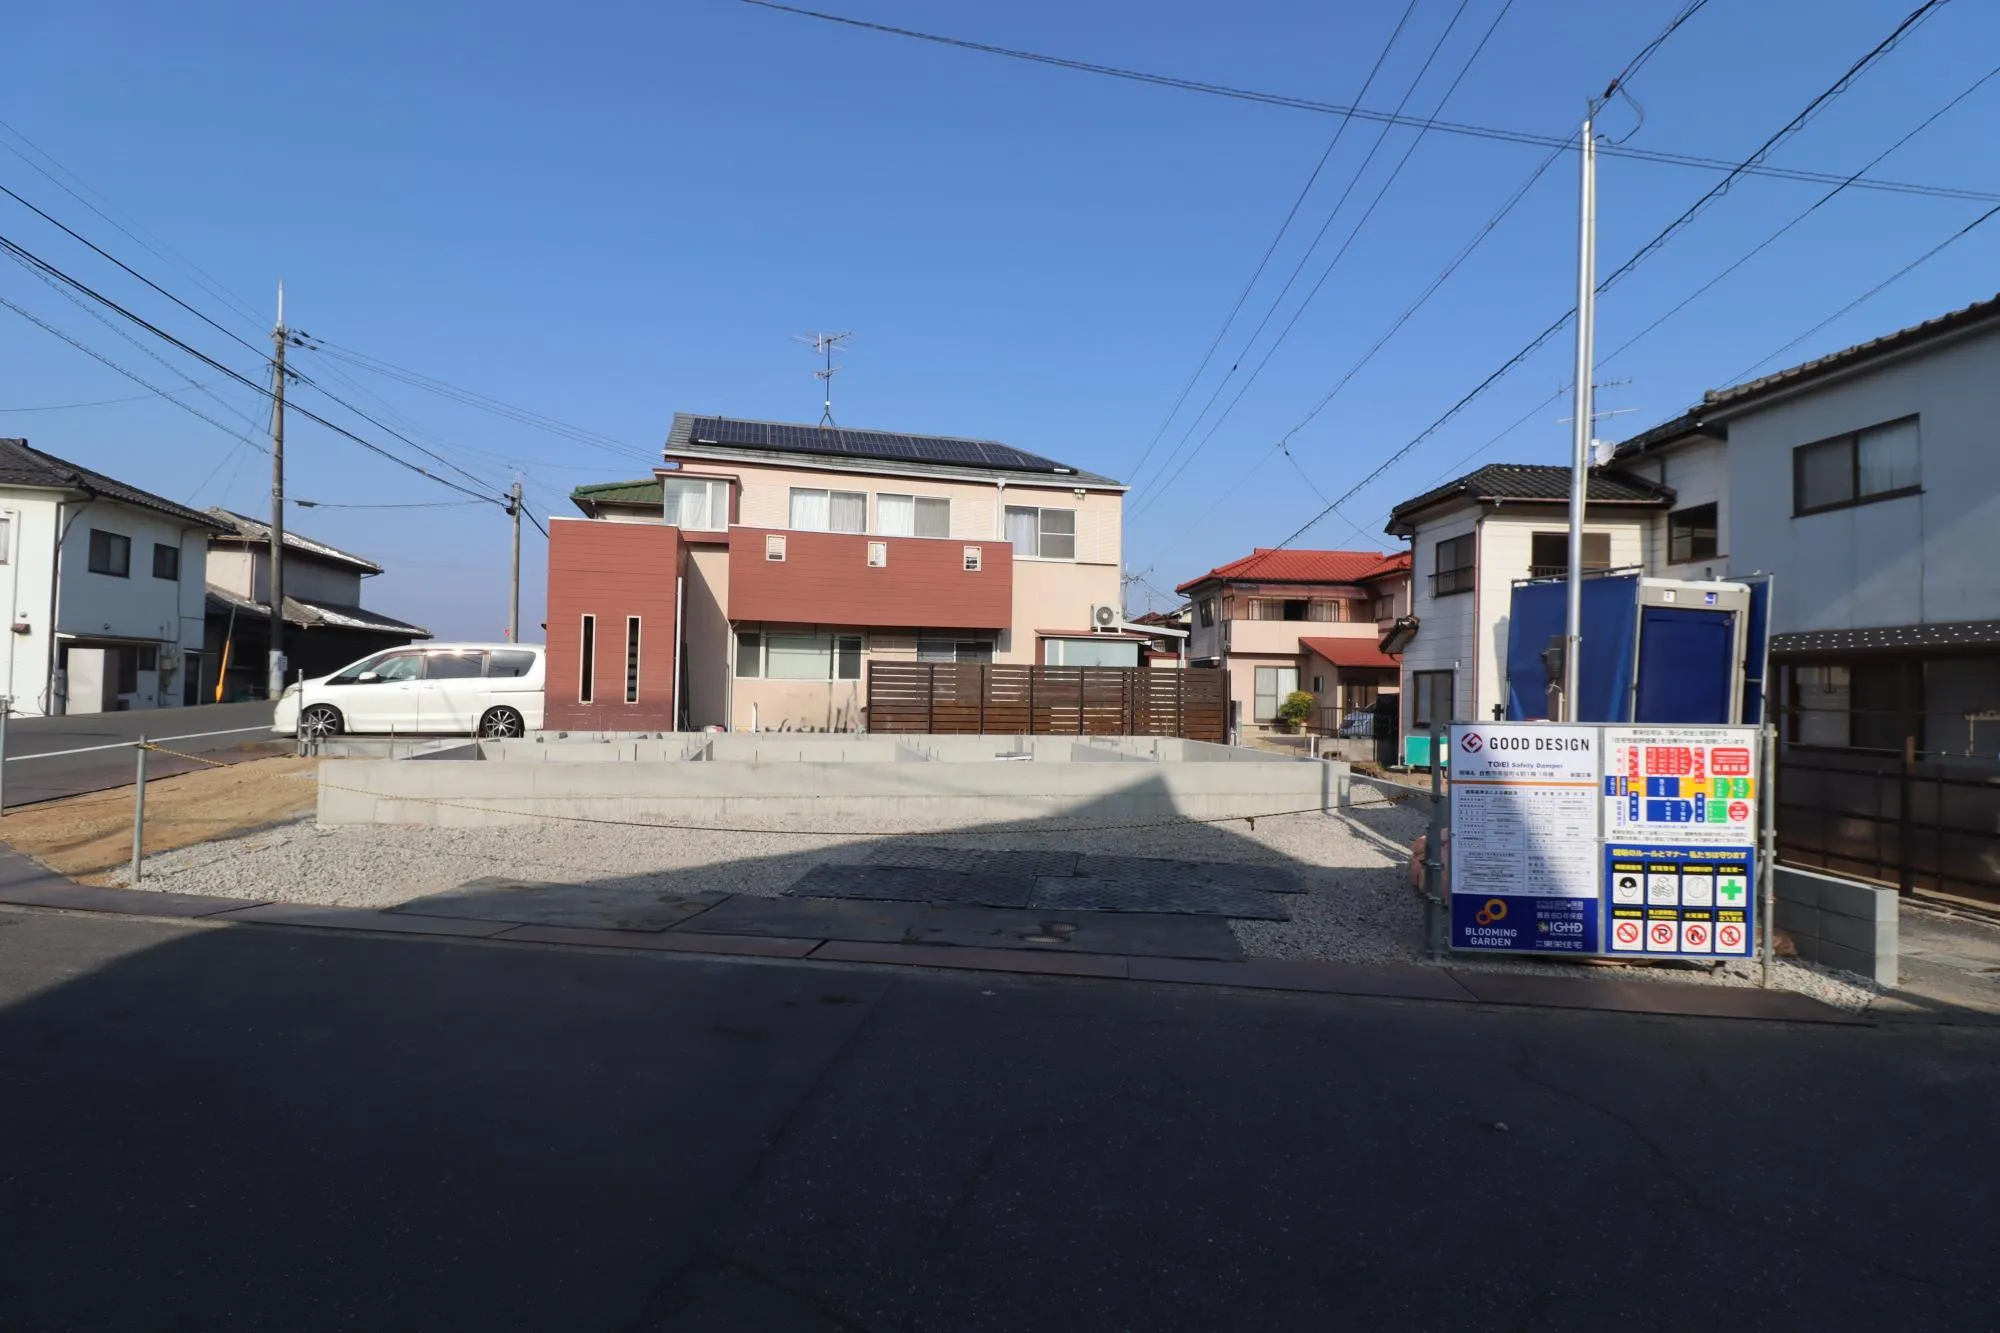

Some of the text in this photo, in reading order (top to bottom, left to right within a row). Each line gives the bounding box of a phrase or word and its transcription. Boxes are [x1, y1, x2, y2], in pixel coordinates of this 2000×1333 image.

[1490, 737, 1590, 751] GOOD DESIGN
[1465, 927, 1517, 937] BLOOMING
[1470, 938, 1511, 946] GARDEN
